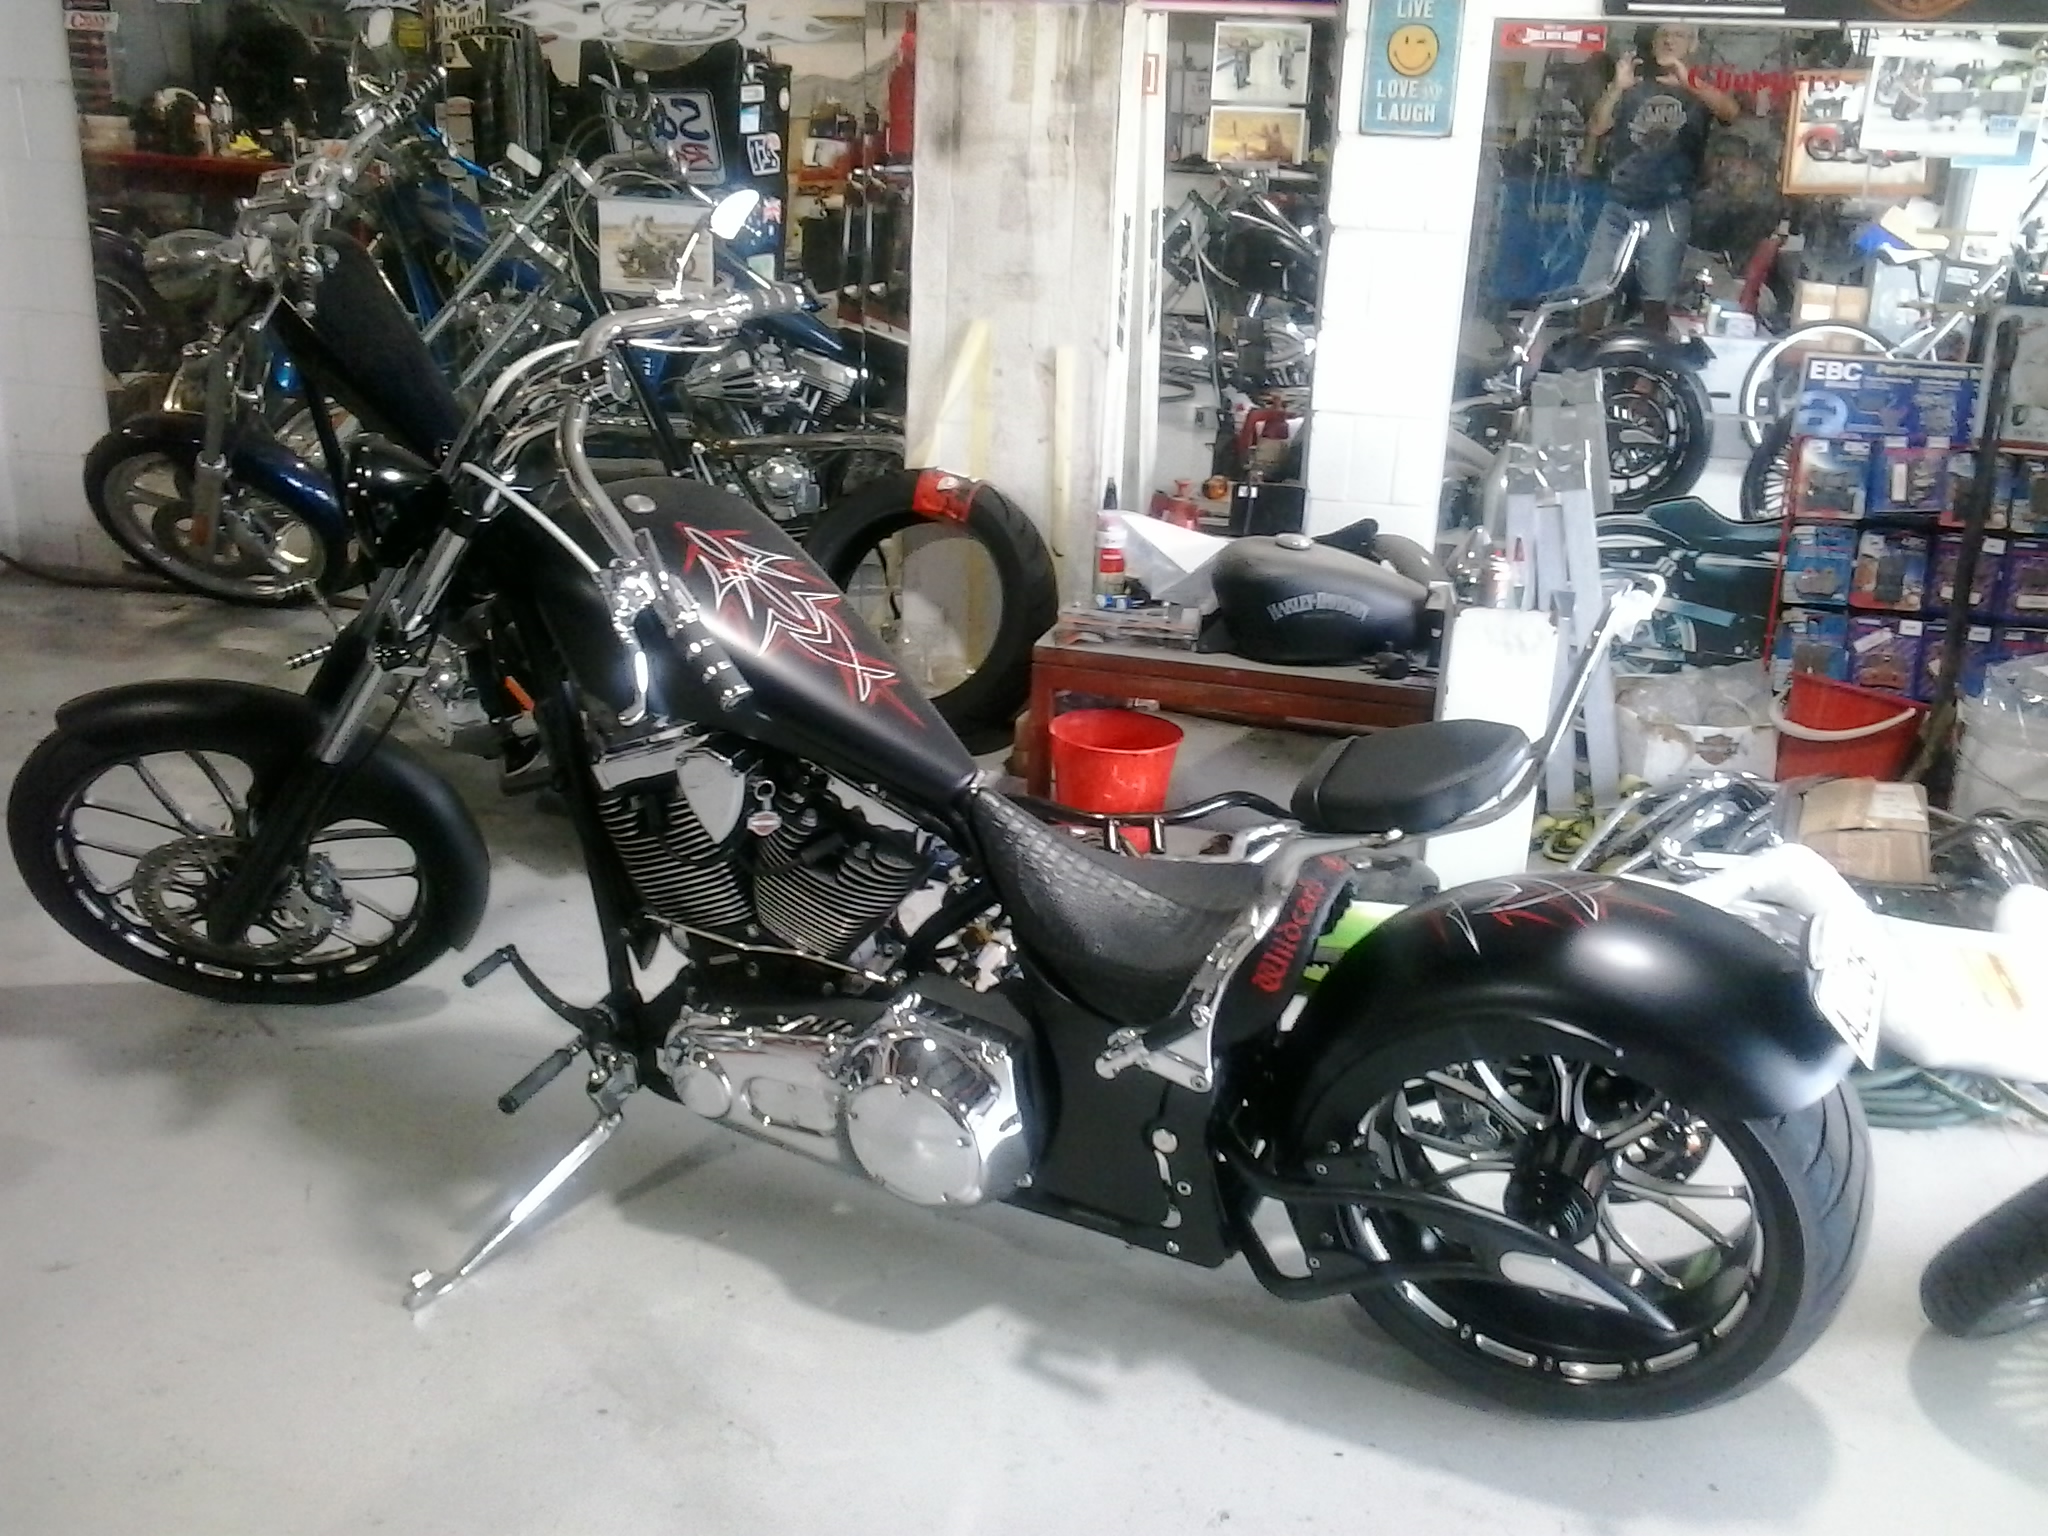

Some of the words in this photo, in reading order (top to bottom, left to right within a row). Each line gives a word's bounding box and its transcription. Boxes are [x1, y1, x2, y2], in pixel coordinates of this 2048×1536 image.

[1397, 0, 1434, 18] LIVE
[1376, 80, 1419, 98] LOVE
[1376, 102, 1436, 122] LAUGH
[1810, 360, 1863, 380] EBC
